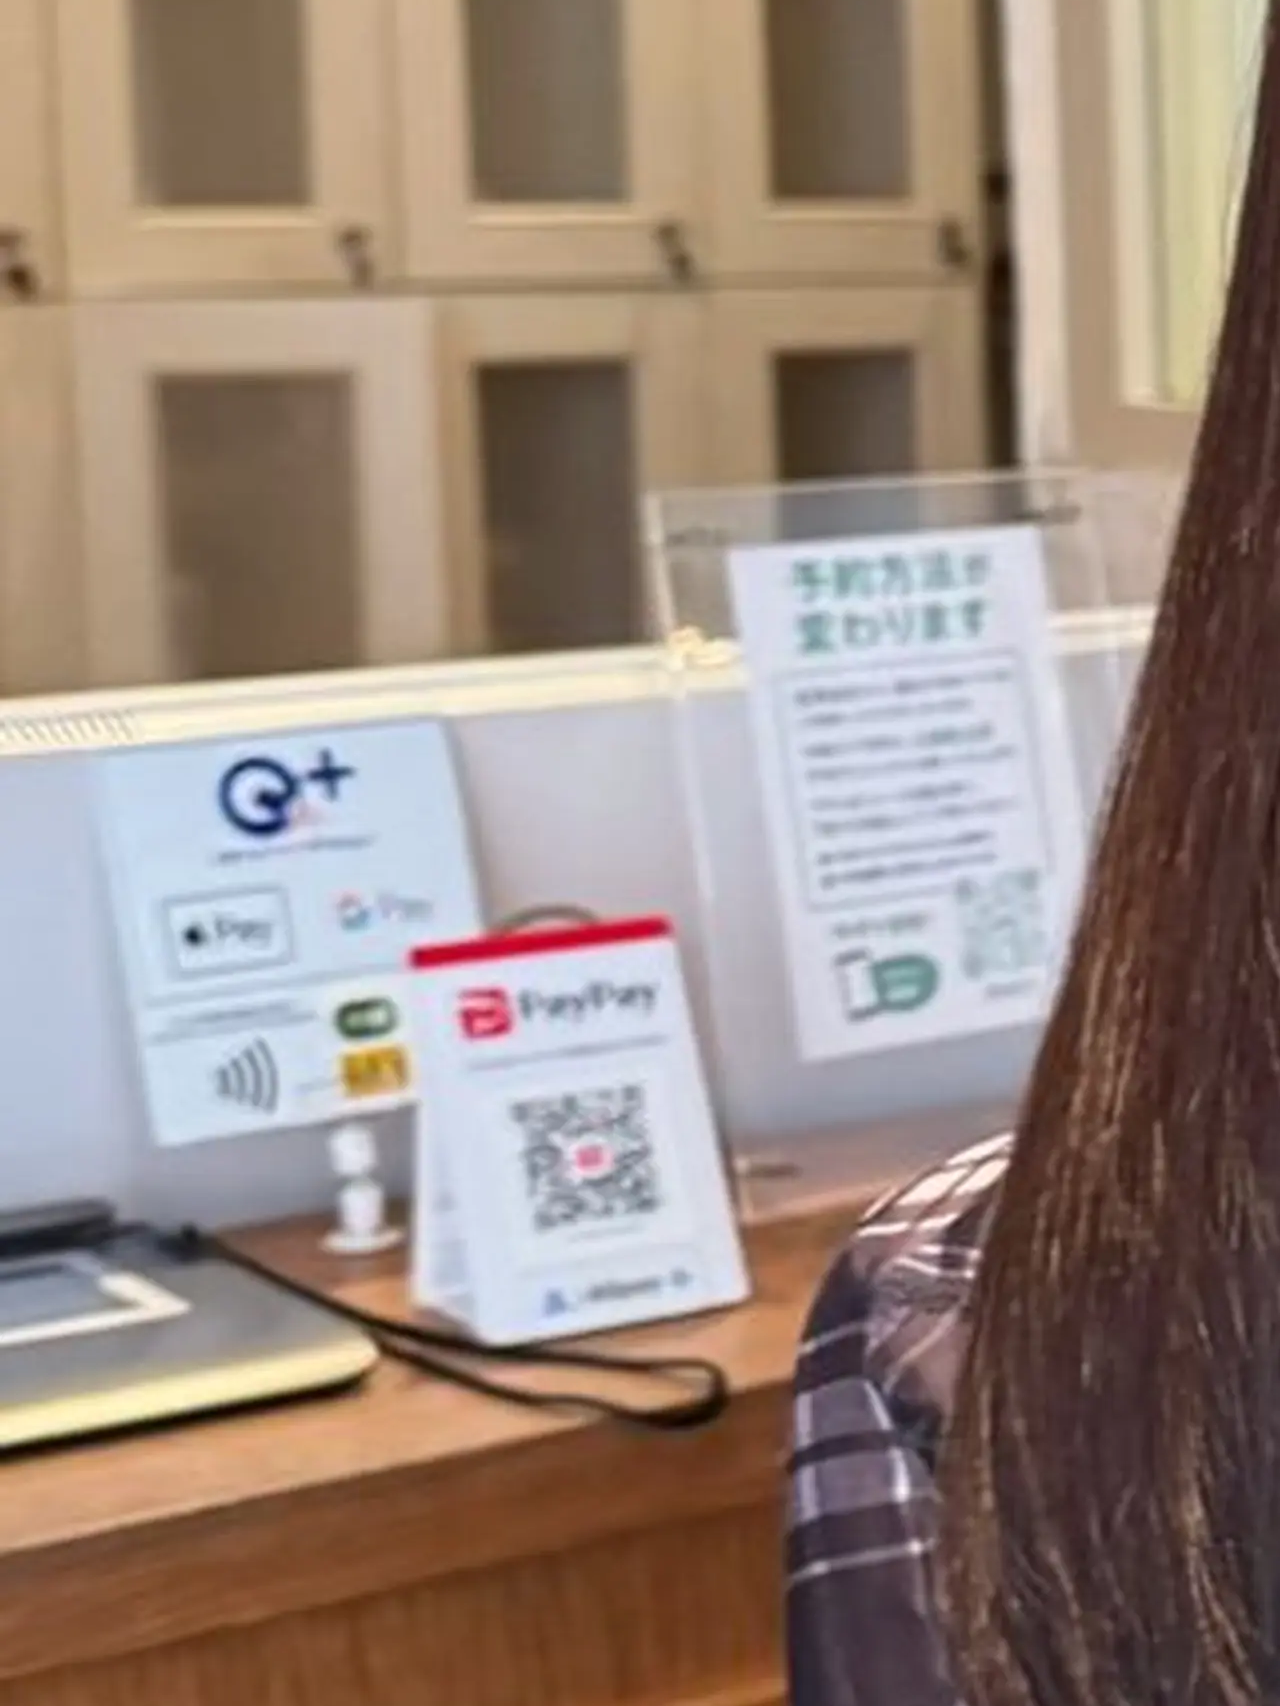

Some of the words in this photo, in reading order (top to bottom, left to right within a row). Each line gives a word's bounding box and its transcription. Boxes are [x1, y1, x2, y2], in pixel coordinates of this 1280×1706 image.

[796, 598, 986, 655] 変わります
[517, 980, 658, 1024] PayPay
